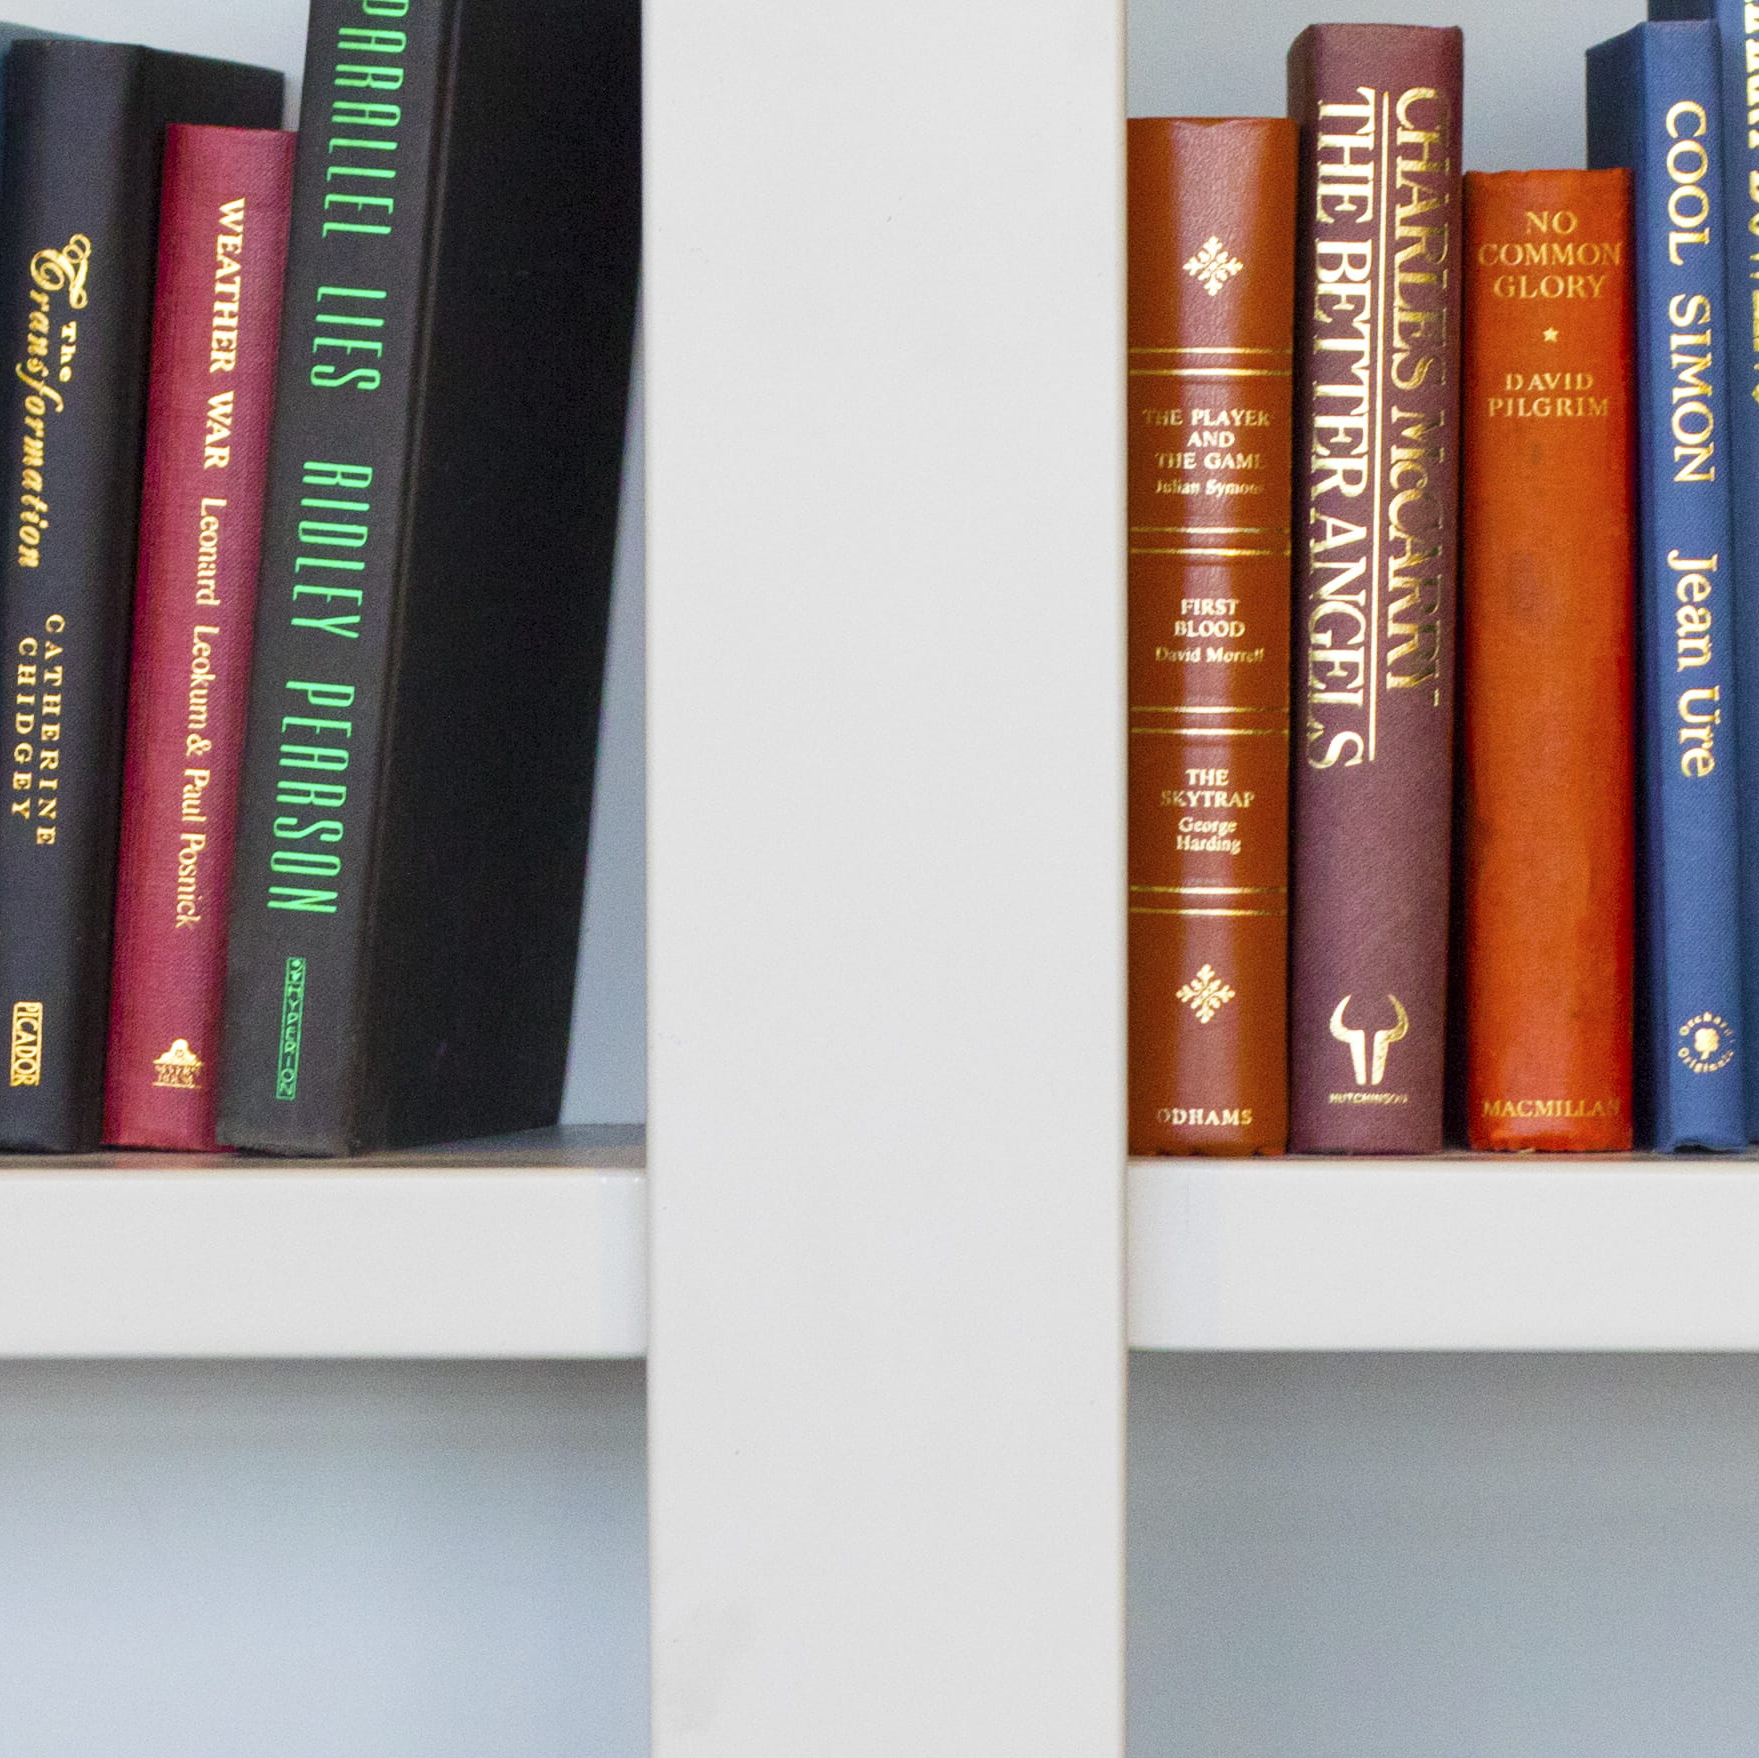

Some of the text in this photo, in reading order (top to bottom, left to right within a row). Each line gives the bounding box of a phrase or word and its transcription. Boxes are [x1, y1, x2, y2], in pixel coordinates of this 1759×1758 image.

[1526, 211, 1578, 235] NO
[1494, 274, 1606, 300] GLORY
[1665, 100, 1717, 483] COOL SIMON
[203, 197, 246, 469] WEATHER WAR
[1506, 372, 1593, 390] DAVID
[267, 285, 388, 913] LIES PEARSON
[1181, 599, 1239, 616] FIRST
[1174, 620, 1245, 638] BLOOD
[12, 637, 38, 819] CHIDGEY
[36, 613, 65, 845] CATHERINE
[1185, 770, 1229, 786] THE
